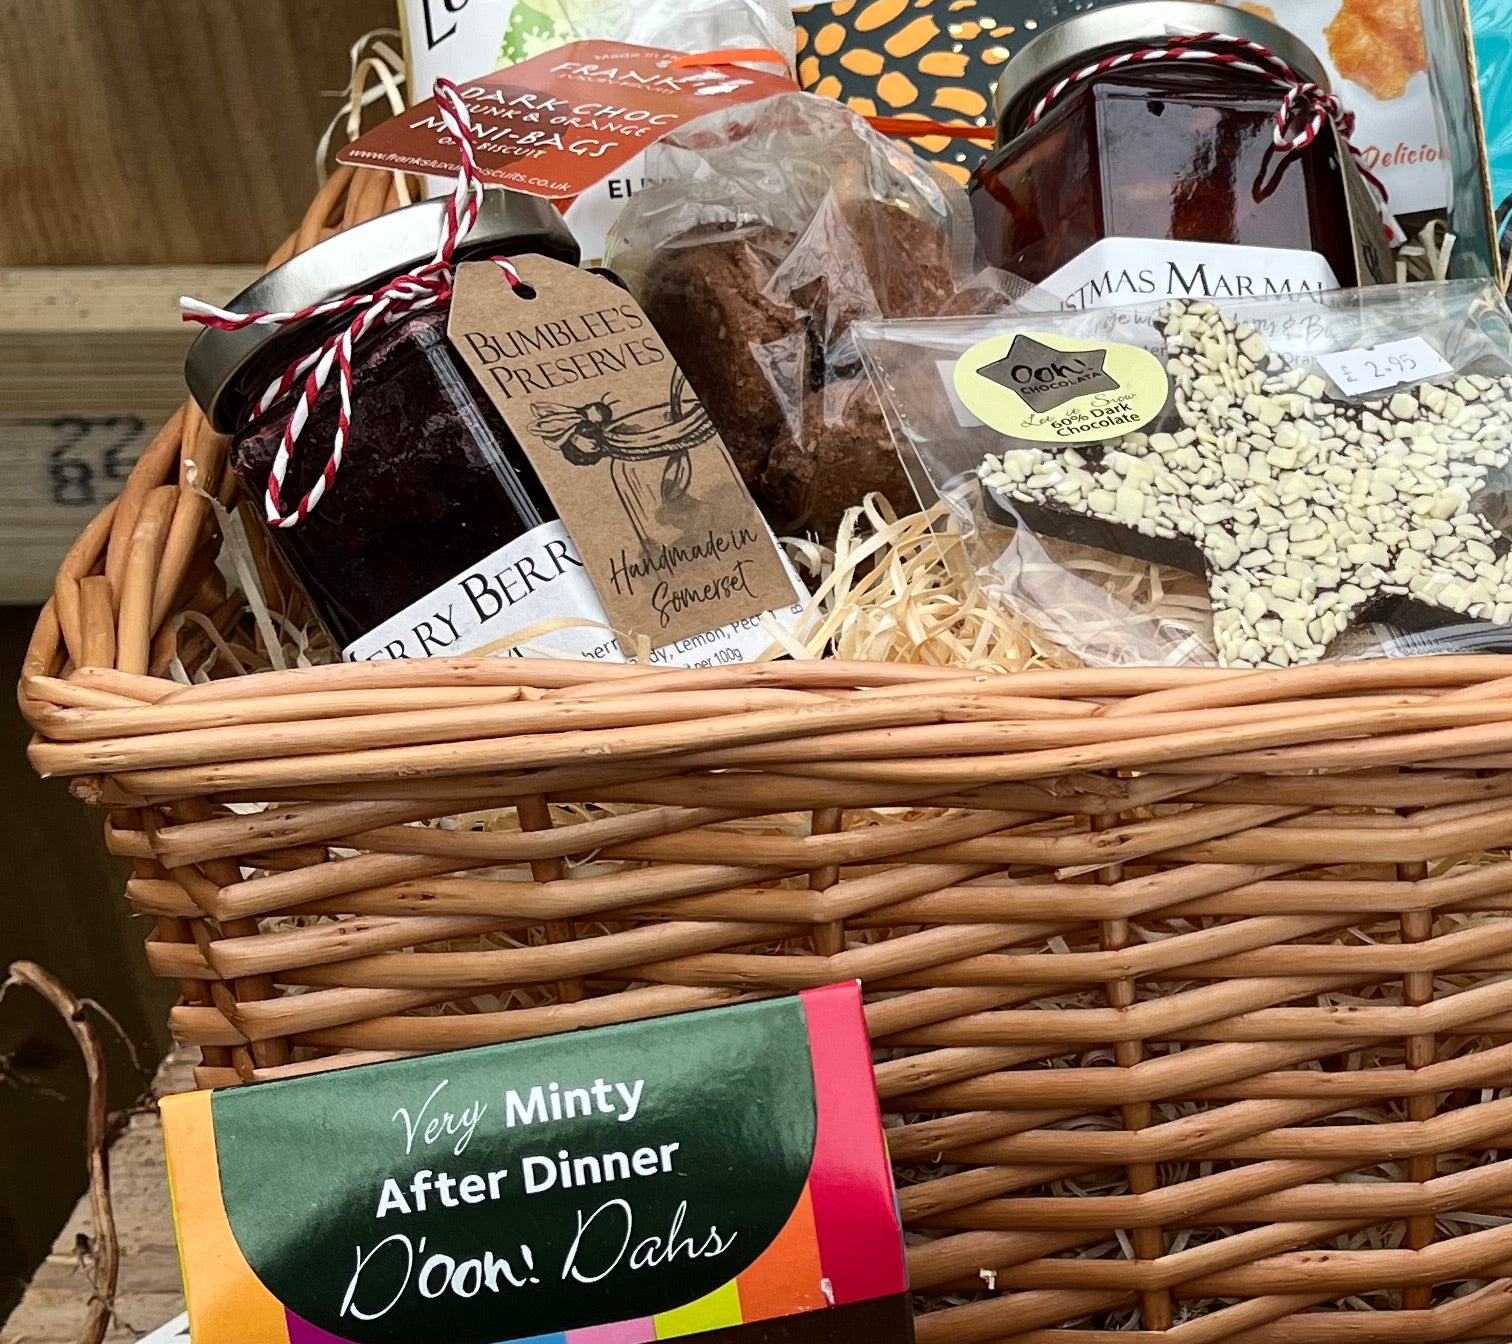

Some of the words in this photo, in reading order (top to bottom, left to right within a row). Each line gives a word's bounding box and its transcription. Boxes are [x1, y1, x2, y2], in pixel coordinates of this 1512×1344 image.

[459, 85, 569, 112] DARK
[572, 98, 679, 127] CHOC
[522, 111, 540, 123] &
[550, 115, 652, 138] ORANGE
[409, 114, 619, 158] MNI-BAGS
[477, 141, 548, 159] BISCUIT
[463, 303, 647, 368] BUMBLEE'S
[485, 337, 665, 401] PRESERVES
[1010, 358, 1094, 384] Ooh!
[1020, 371, 1102, 395] CHOCOLATA
[1364, 353, 1418, 378] 2.95
[1050, 413, 1089, 430] 60%
[1089, 402, 1133, 419] Dark
[1056, 413, 1142, 438] Chocolate
[459, 535, 586, 625] BERR
[610, 529, 727, 597] Handmade
[727, 526, 759, 554] in
[651, 558, 758, 630] Somerset
[672, 626, 732, 655] Lemon,
[712, 646, 744, 665] 100g
[390, 1074, 490, 1157] Very
[502, 1076, 648, 1132] Minty
[374, 1162, 510, 1220] After
[520, 1135, 683, 1196] Dinner
[338, 1228, 540, 1324] D'ooh!
[558, 1196, 740, 1288] Dahs
